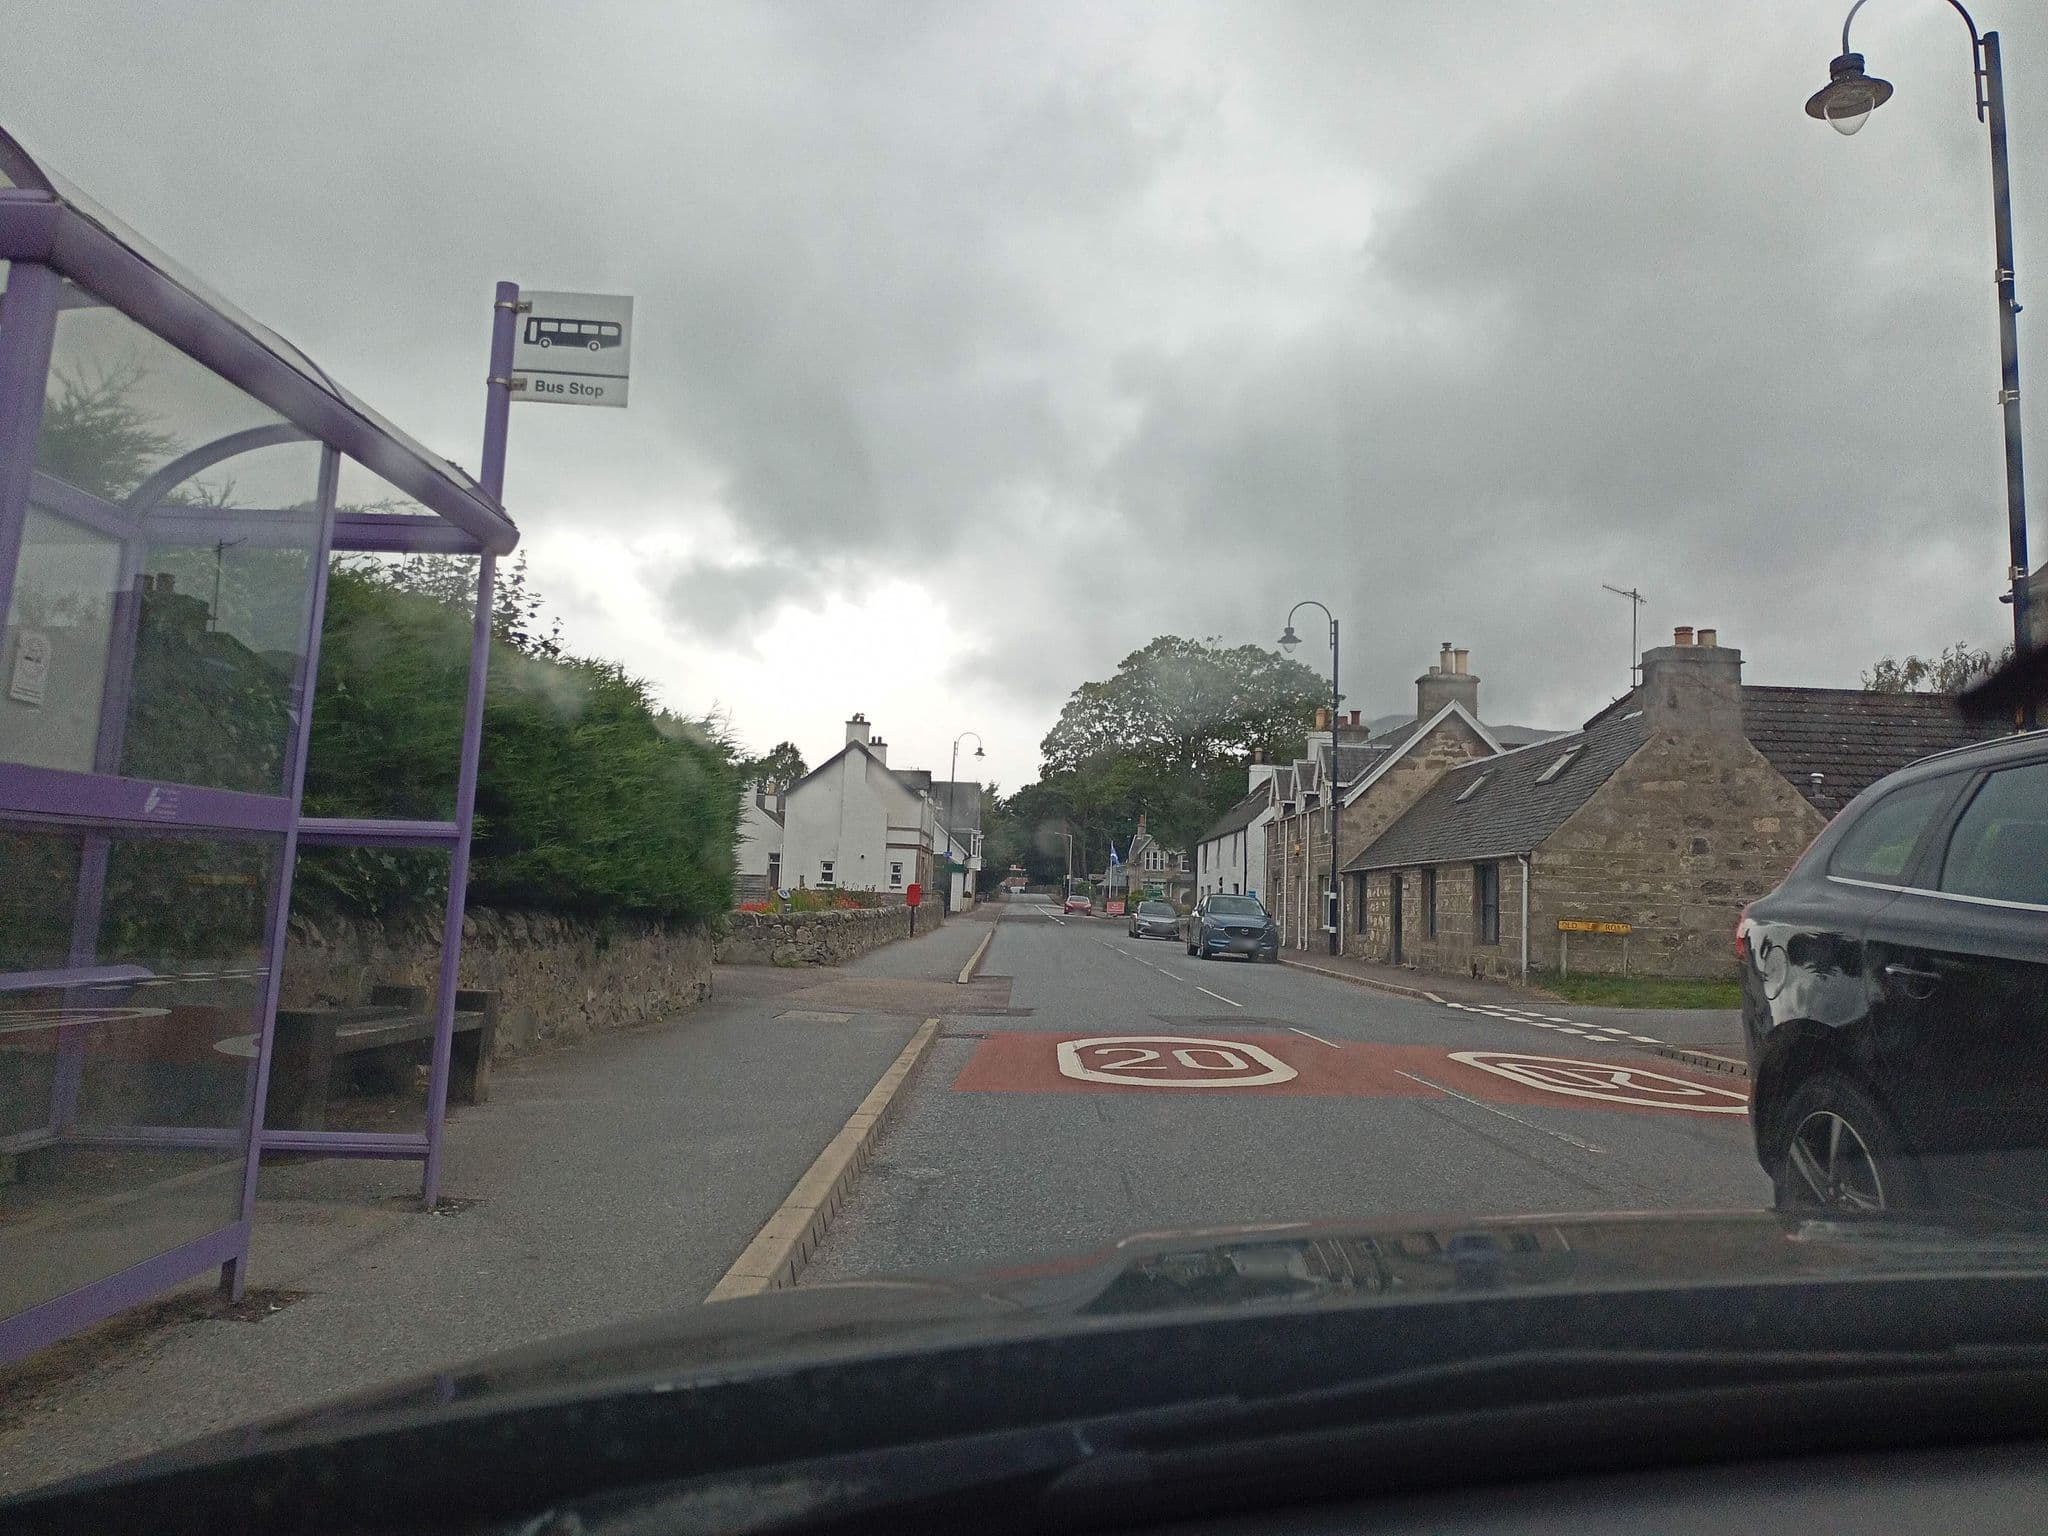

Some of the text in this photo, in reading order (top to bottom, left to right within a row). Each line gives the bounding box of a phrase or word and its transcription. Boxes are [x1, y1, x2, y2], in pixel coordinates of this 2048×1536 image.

[535, 380, 604, 398] Bus Stop
[1561, 921, 1578, 929] OLD
[1094, 1048, 1249, 1070] 20
